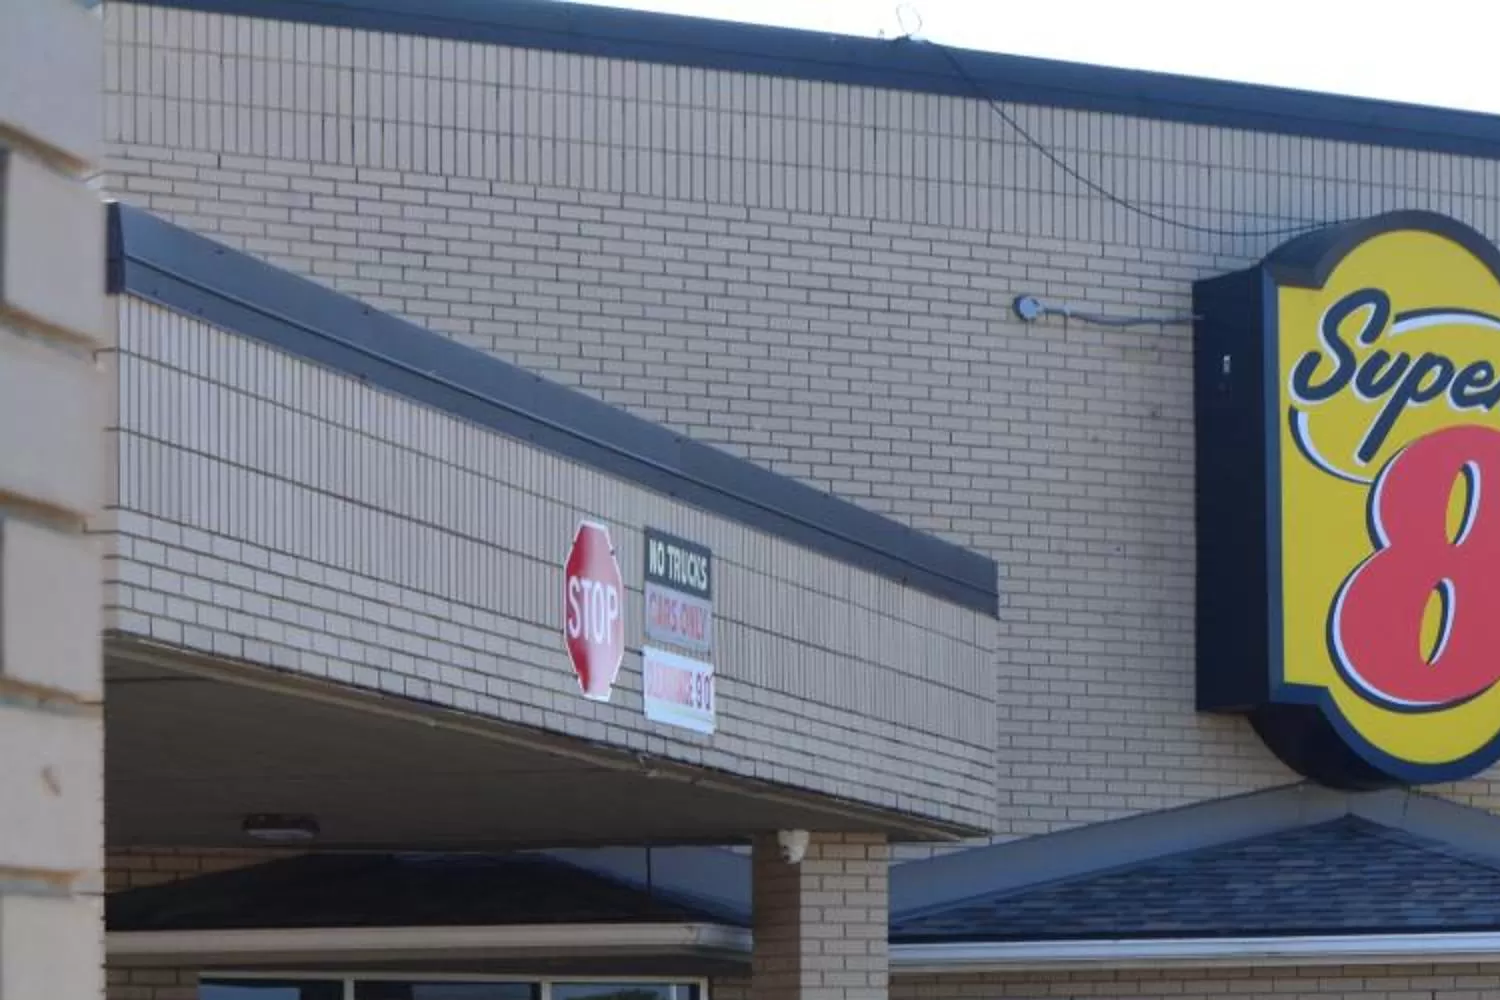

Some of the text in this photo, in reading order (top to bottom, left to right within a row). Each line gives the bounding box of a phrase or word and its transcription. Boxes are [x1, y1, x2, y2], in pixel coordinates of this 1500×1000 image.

[649, 538, 708, 592] NO TRUCKS
[567, 574, 618, 645] STOP
